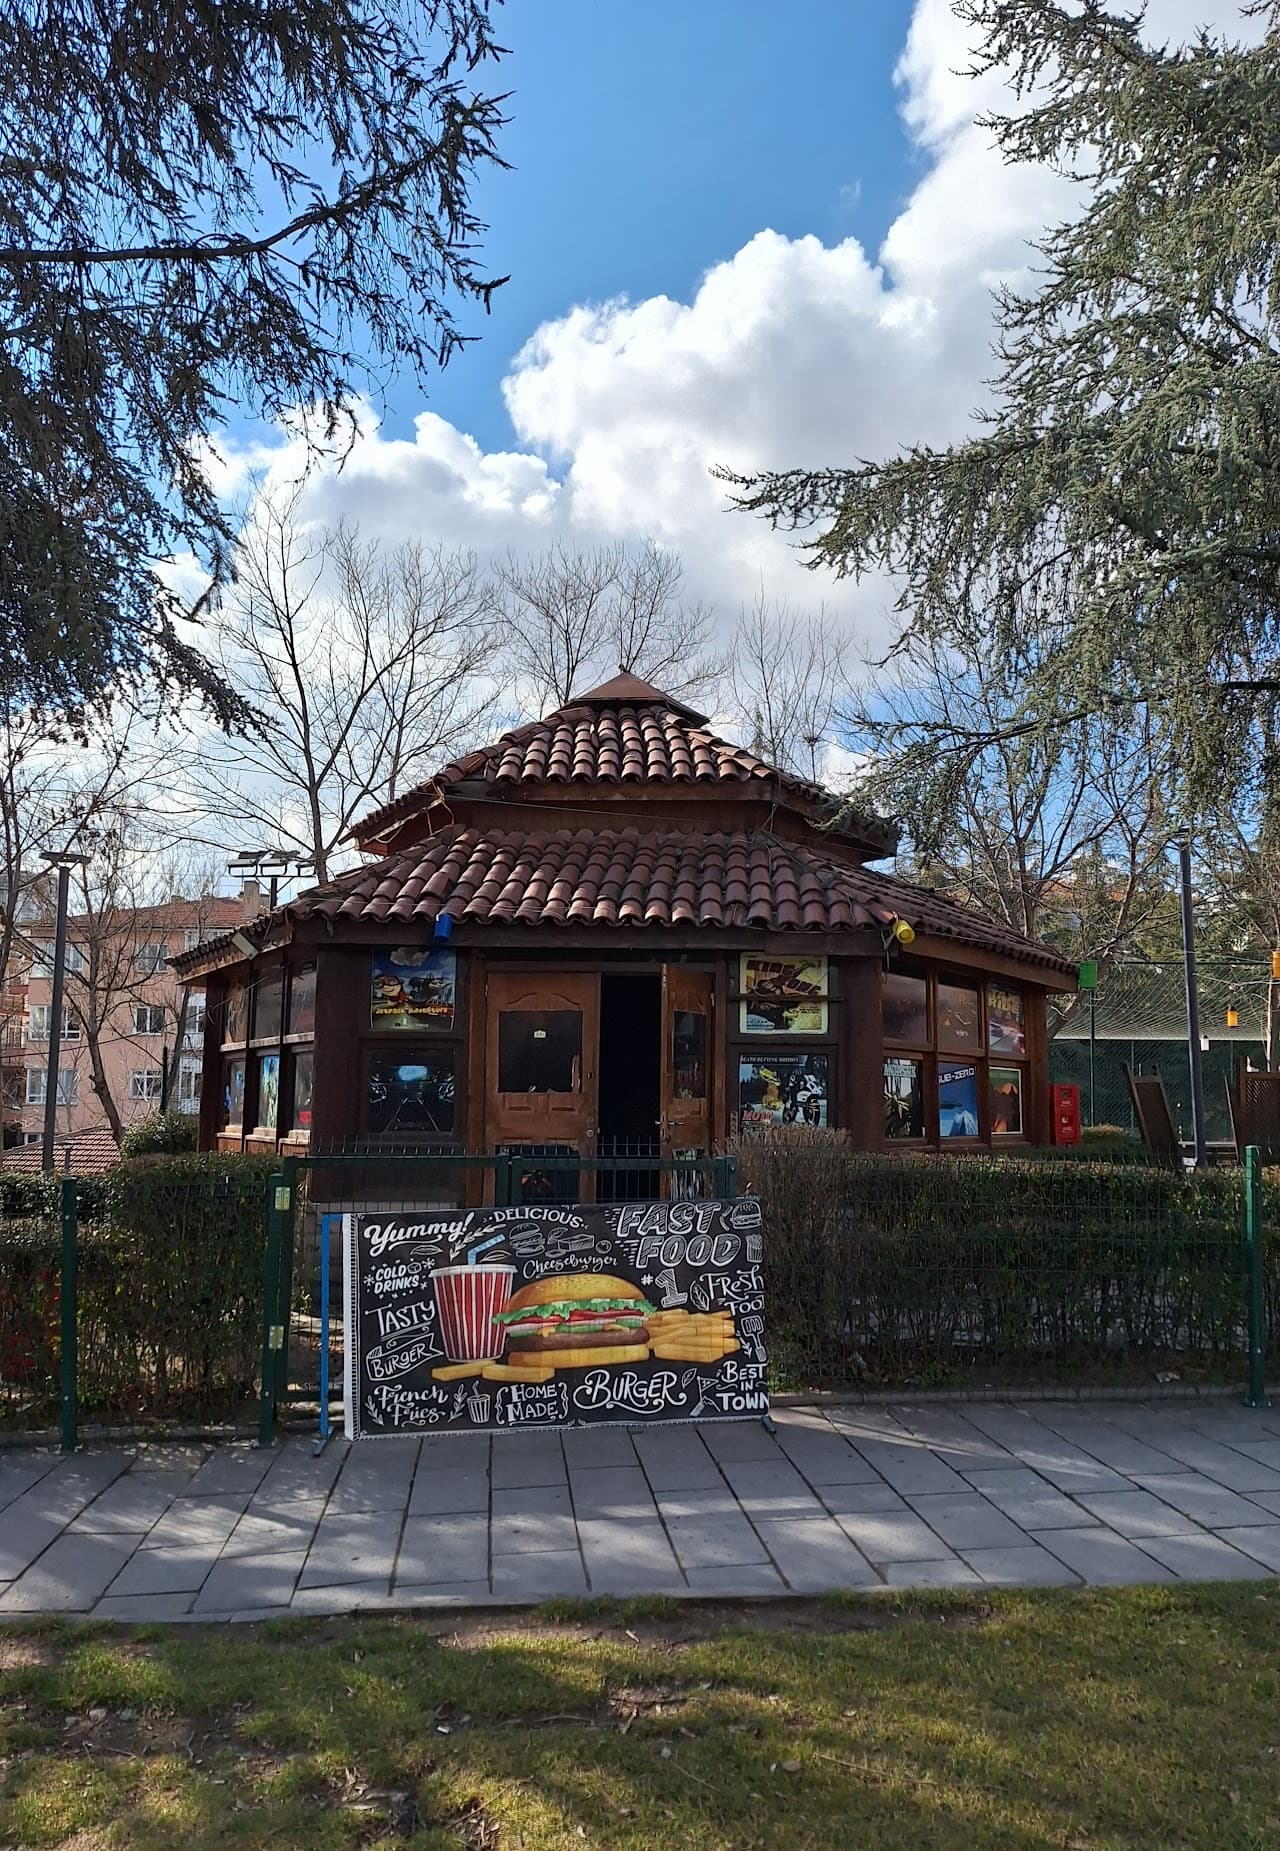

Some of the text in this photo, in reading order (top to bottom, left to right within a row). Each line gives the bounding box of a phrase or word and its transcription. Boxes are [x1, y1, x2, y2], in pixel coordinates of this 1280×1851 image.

[493, 1207, 584, 1229] DELICIOUS
[616, 1202, 722, 1238] FAST
[363, 1211, 475, 1258] Yummy!
[635, 1232, 742, 1269] FOOD
[375, 1264, 407, 1281] COLD
[522, 1253, 619, 1280] Cheeseburger
[373, 1274, 420, 1295] DRINKS
[364, 1299, 436, 1337] TASTY
[720, 1360, 769, 1384] BEST
[373, 1384, 449, 1410] French
[511, 1383, 558, 1403] HOME
[572, 1369, 688, 1410] BURGER
[740, 1379, 754, 1392] IN
[386, 1401, 447, 1426] Fries
[506, 1400, 558, 1423] MADE
